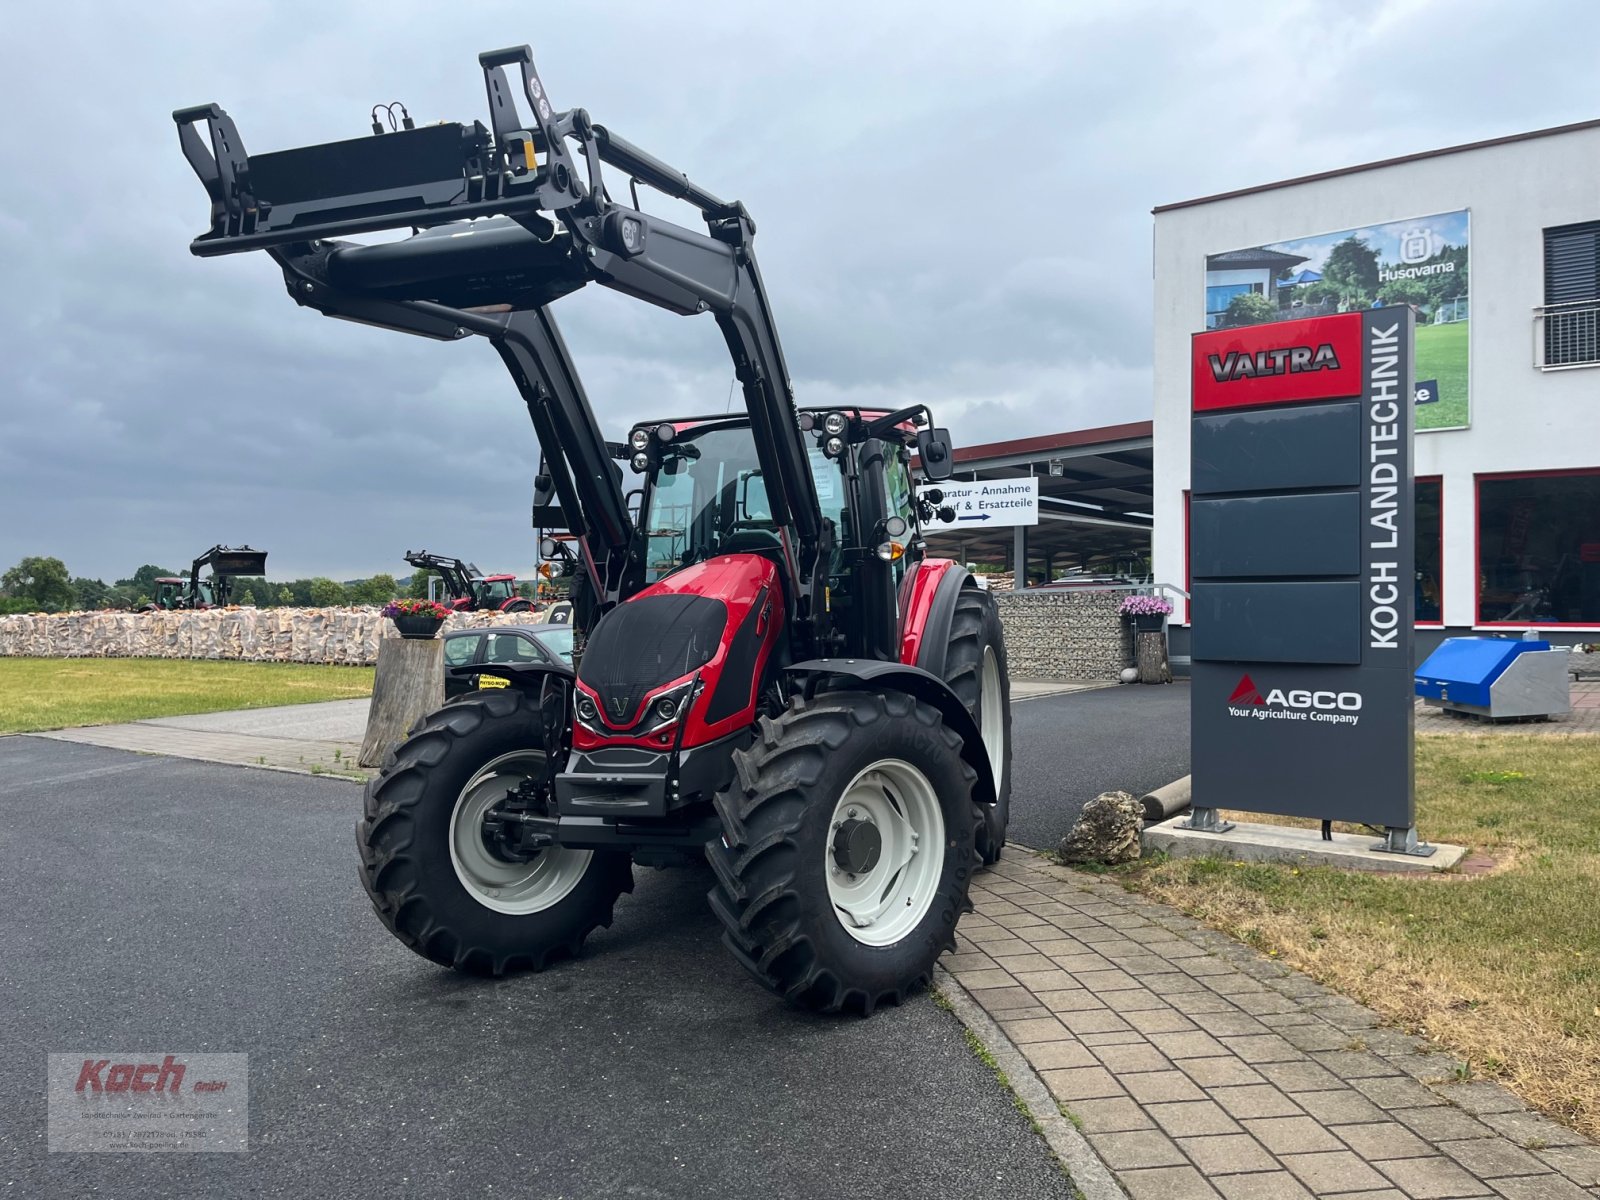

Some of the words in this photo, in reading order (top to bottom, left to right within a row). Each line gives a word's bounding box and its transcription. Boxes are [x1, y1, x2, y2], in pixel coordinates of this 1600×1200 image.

[1378, 262, 1455, 282] Husqvarna
[1208, 343, 1341, 382] VALTRA
[1370, 322, 1399, 549] LANDTECHNIK
[981, 484, 1031, 496] Annahme
[978, 498, 1033, 510] Ersatzteile
[1370, 562, 1399, 649] KOCH
[1265, 689, 1363, 711] AGCO
[1228, 707, 1251, 717] Your
[1252, 708, 1307, 720] Agriculture
[1310, 711, 1359, 725] Company
